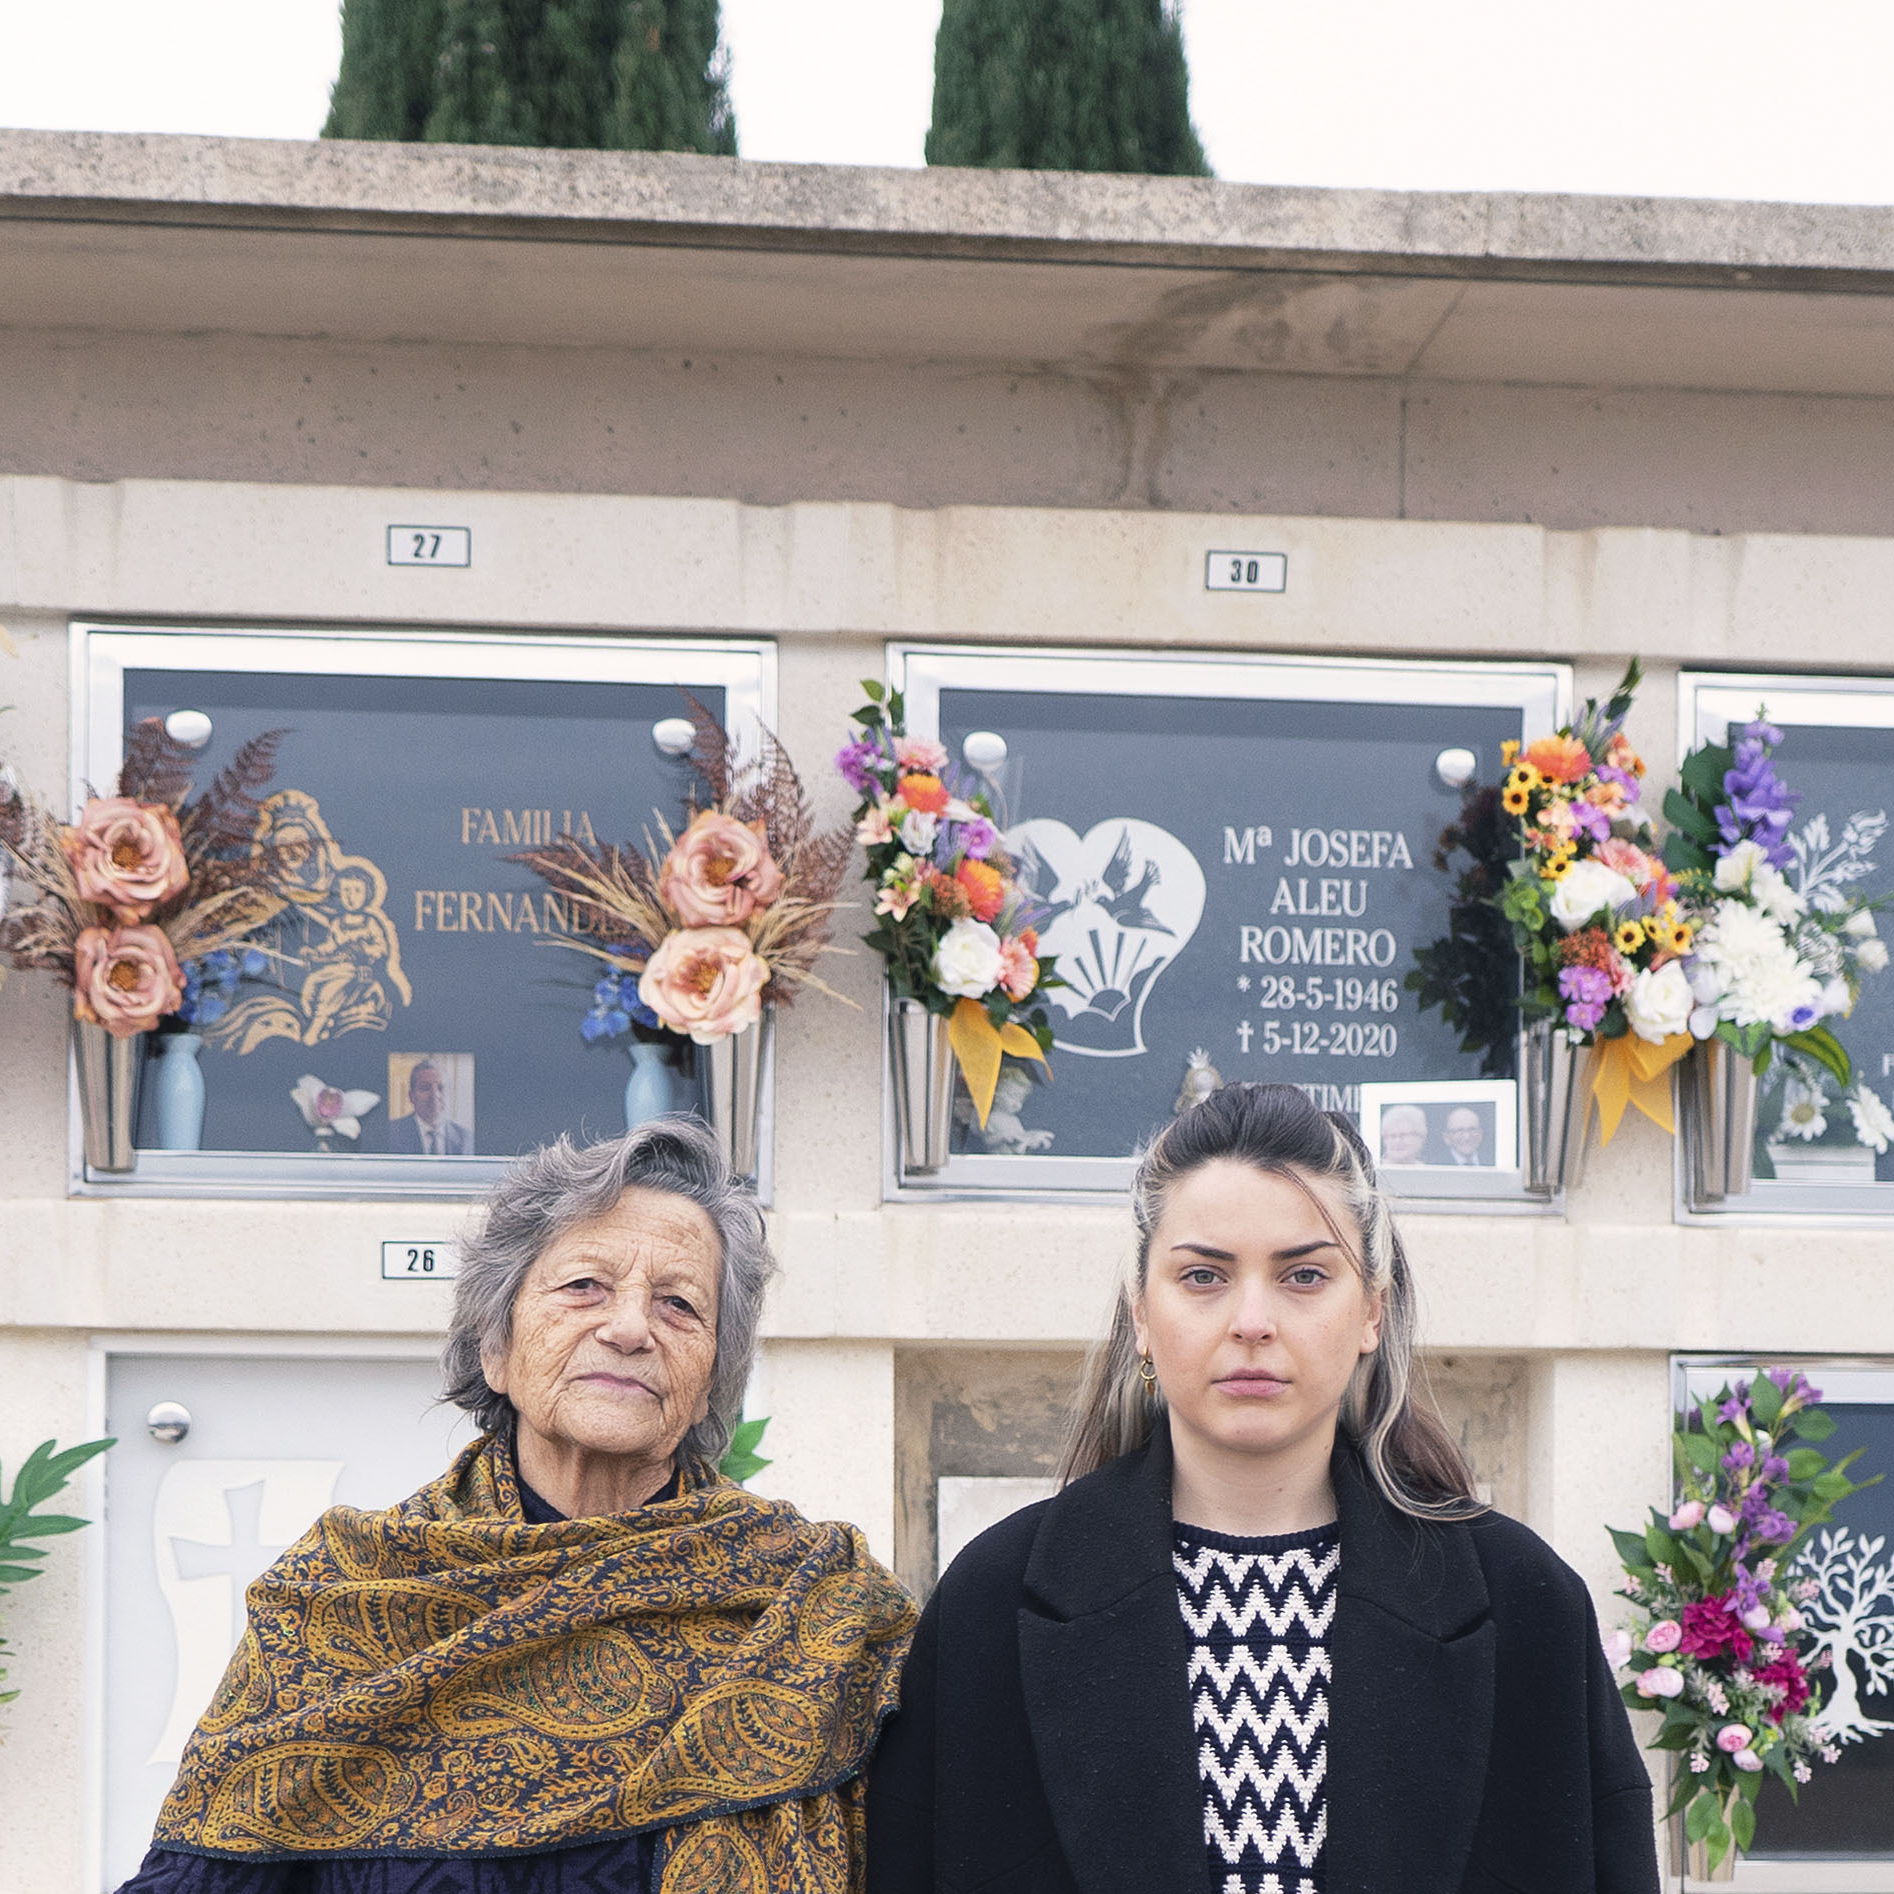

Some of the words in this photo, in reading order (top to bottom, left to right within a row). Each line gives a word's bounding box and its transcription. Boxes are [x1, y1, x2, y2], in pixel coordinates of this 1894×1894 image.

[413, 533, 442, 558] 27
[1230, 560, 1259, 584] 30
[1223, 825, 1273, 865] Mª
[1283, 828, 1414, 869] JOSEFA
[1270, 877, 1368, 918] ALEU
[1240, 926, 1397, 967] ROMERO
[1260, 975, 1398, 1013] 28-5-1946
[1263, 1021, 1398, 1058] 5-12-2020
[407, 1249, 435, 1272] 26
